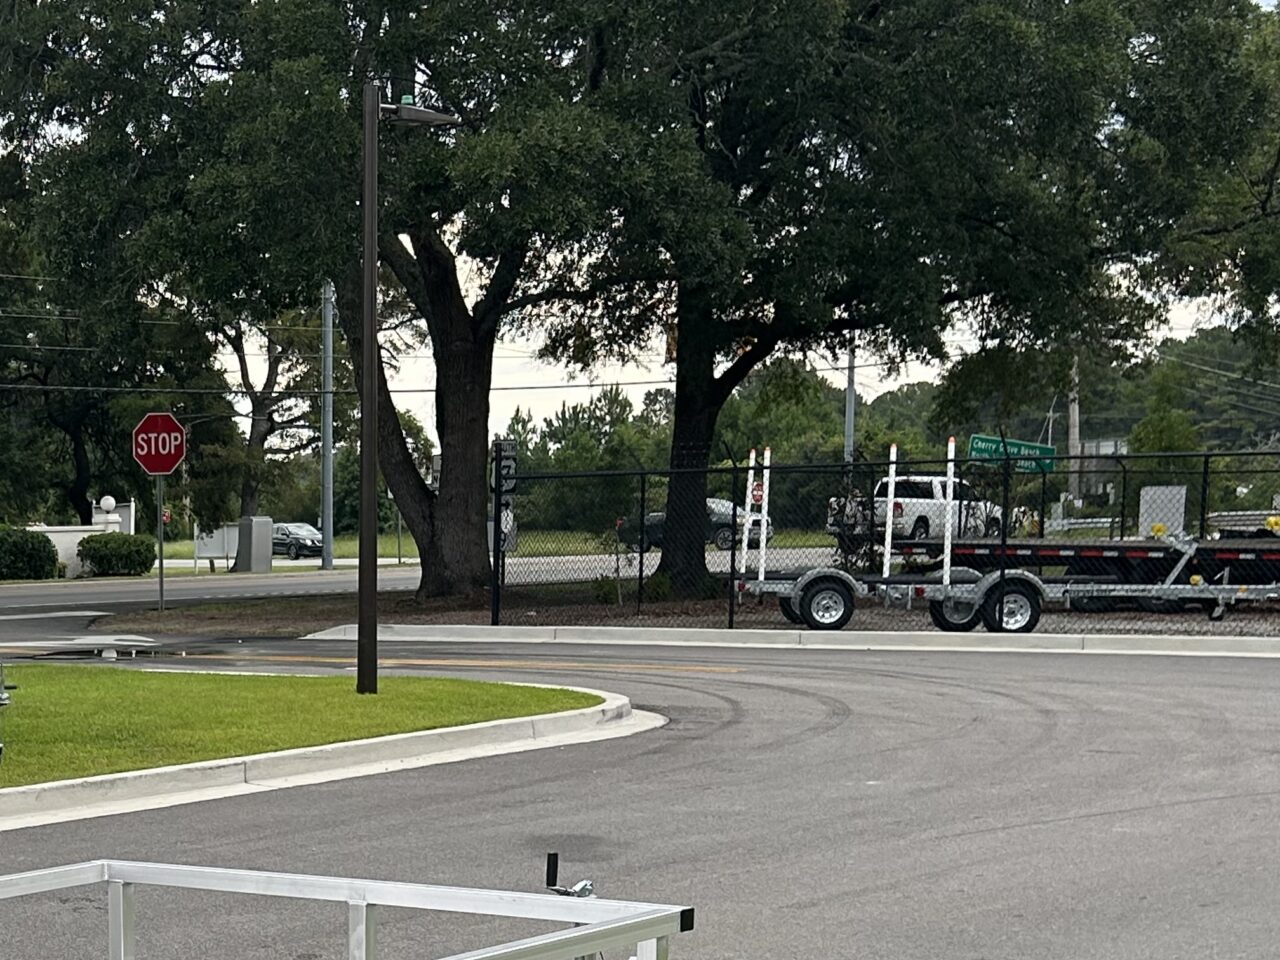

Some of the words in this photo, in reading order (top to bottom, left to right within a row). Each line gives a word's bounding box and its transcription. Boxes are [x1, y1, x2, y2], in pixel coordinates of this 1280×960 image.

[137, 432, 181, 455] STOP
[973, 439, 996, 451] Cherry
[999, 443, 1018, 454] Gove
[1020, 446, 1040, 456] Beach
